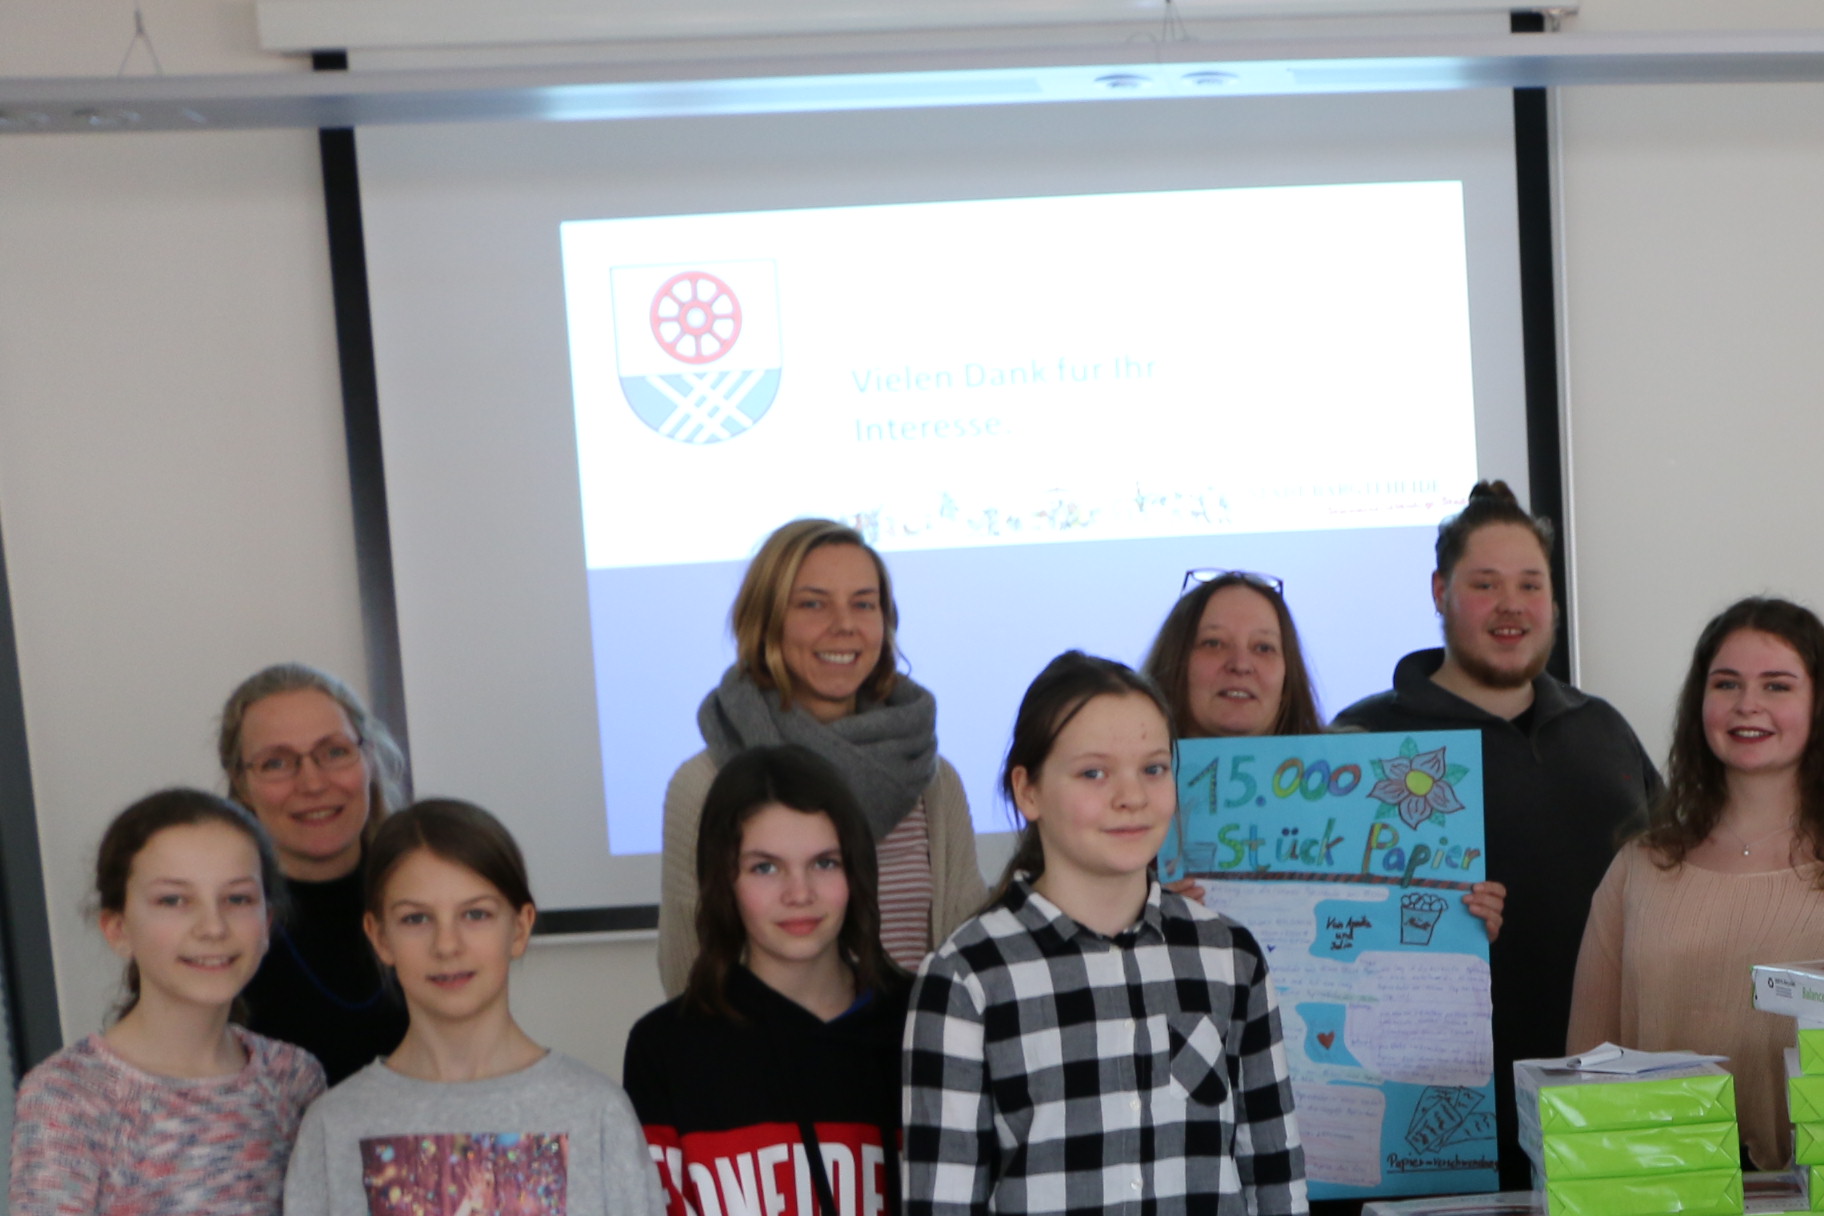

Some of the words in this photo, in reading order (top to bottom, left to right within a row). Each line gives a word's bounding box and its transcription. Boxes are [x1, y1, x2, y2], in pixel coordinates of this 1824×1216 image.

[851, 365, 953, 393] Vielen
[964, 359, 1047, 388] Dank
[1114, 354, 1157, 380] Ihr
[1188, 754, 1361, 815] 15.000
[1218, 817, 1344, 872] Stück
[1362, 821, 1481, 888] Papier
